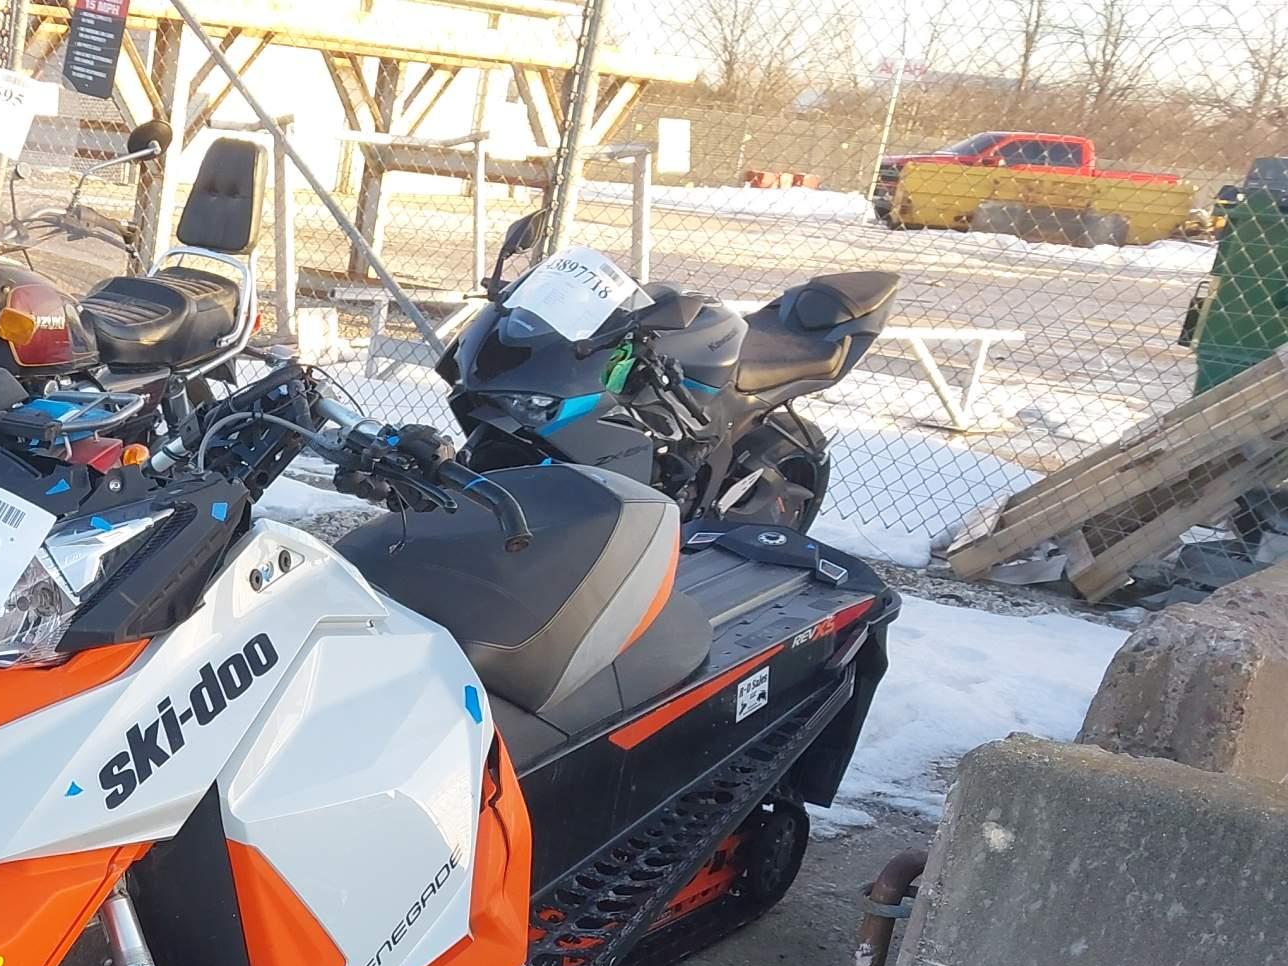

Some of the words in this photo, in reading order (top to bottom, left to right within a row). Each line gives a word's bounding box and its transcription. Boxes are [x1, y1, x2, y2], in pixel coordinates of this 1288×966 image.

[96, 1, 121, 16] MPH
[34, 313, 65, 330] UZUKI
[99, 632, 279, 810] ski-doo
